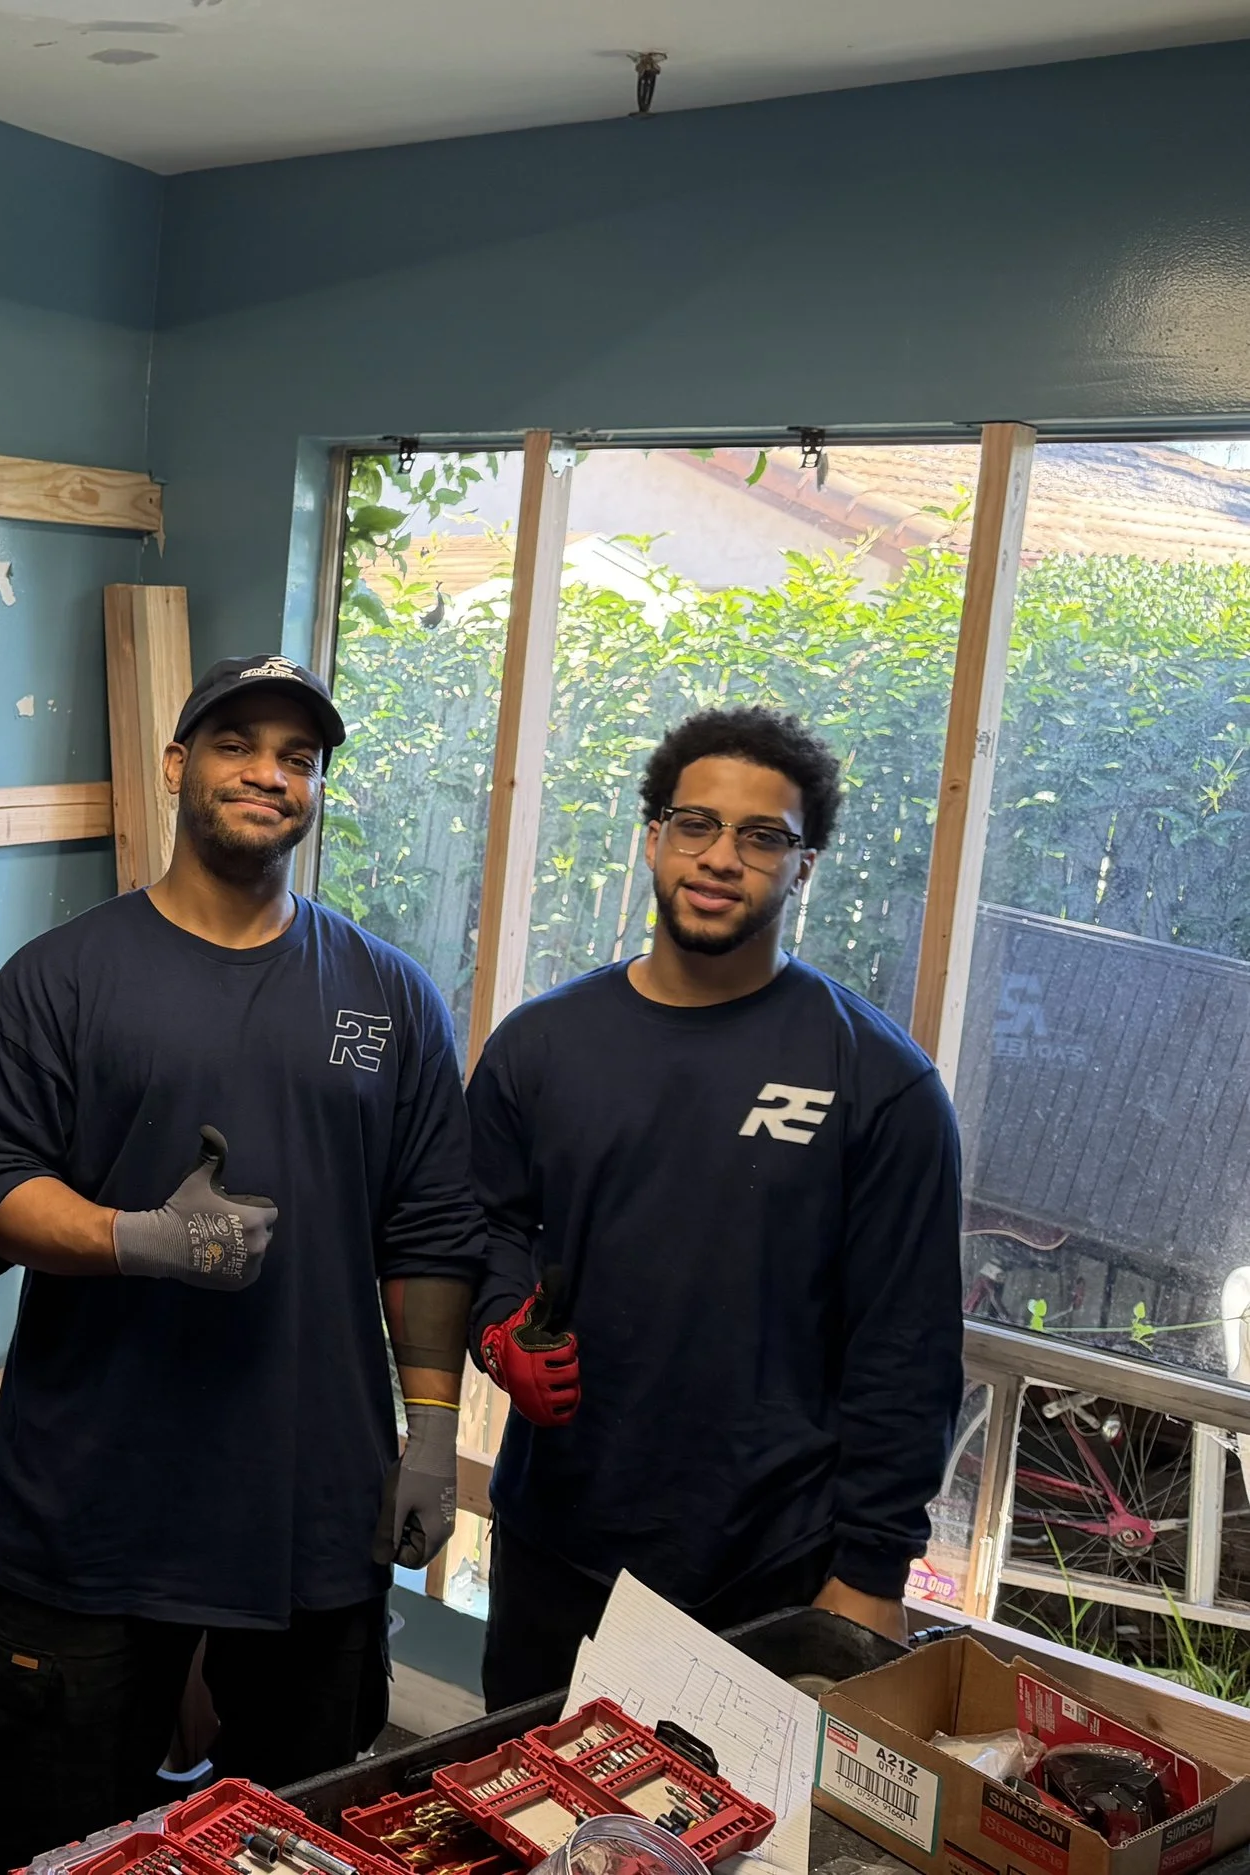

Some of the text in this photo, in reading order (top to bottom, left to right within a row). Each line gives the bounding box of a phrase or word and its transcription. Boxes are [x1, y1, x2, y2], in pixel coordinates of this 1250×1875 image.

[329, 1009, 393, 1073] RE
[738, 1081, 837, 1146] RE
[227, 1213, 248, 1277] MaxiFlex
[876, 1747, 918, 1780] A21Z
[989, 1791, 1064, 1843] SIMPSON
[1165, 1810, 1214, 1844] SIMPSON
